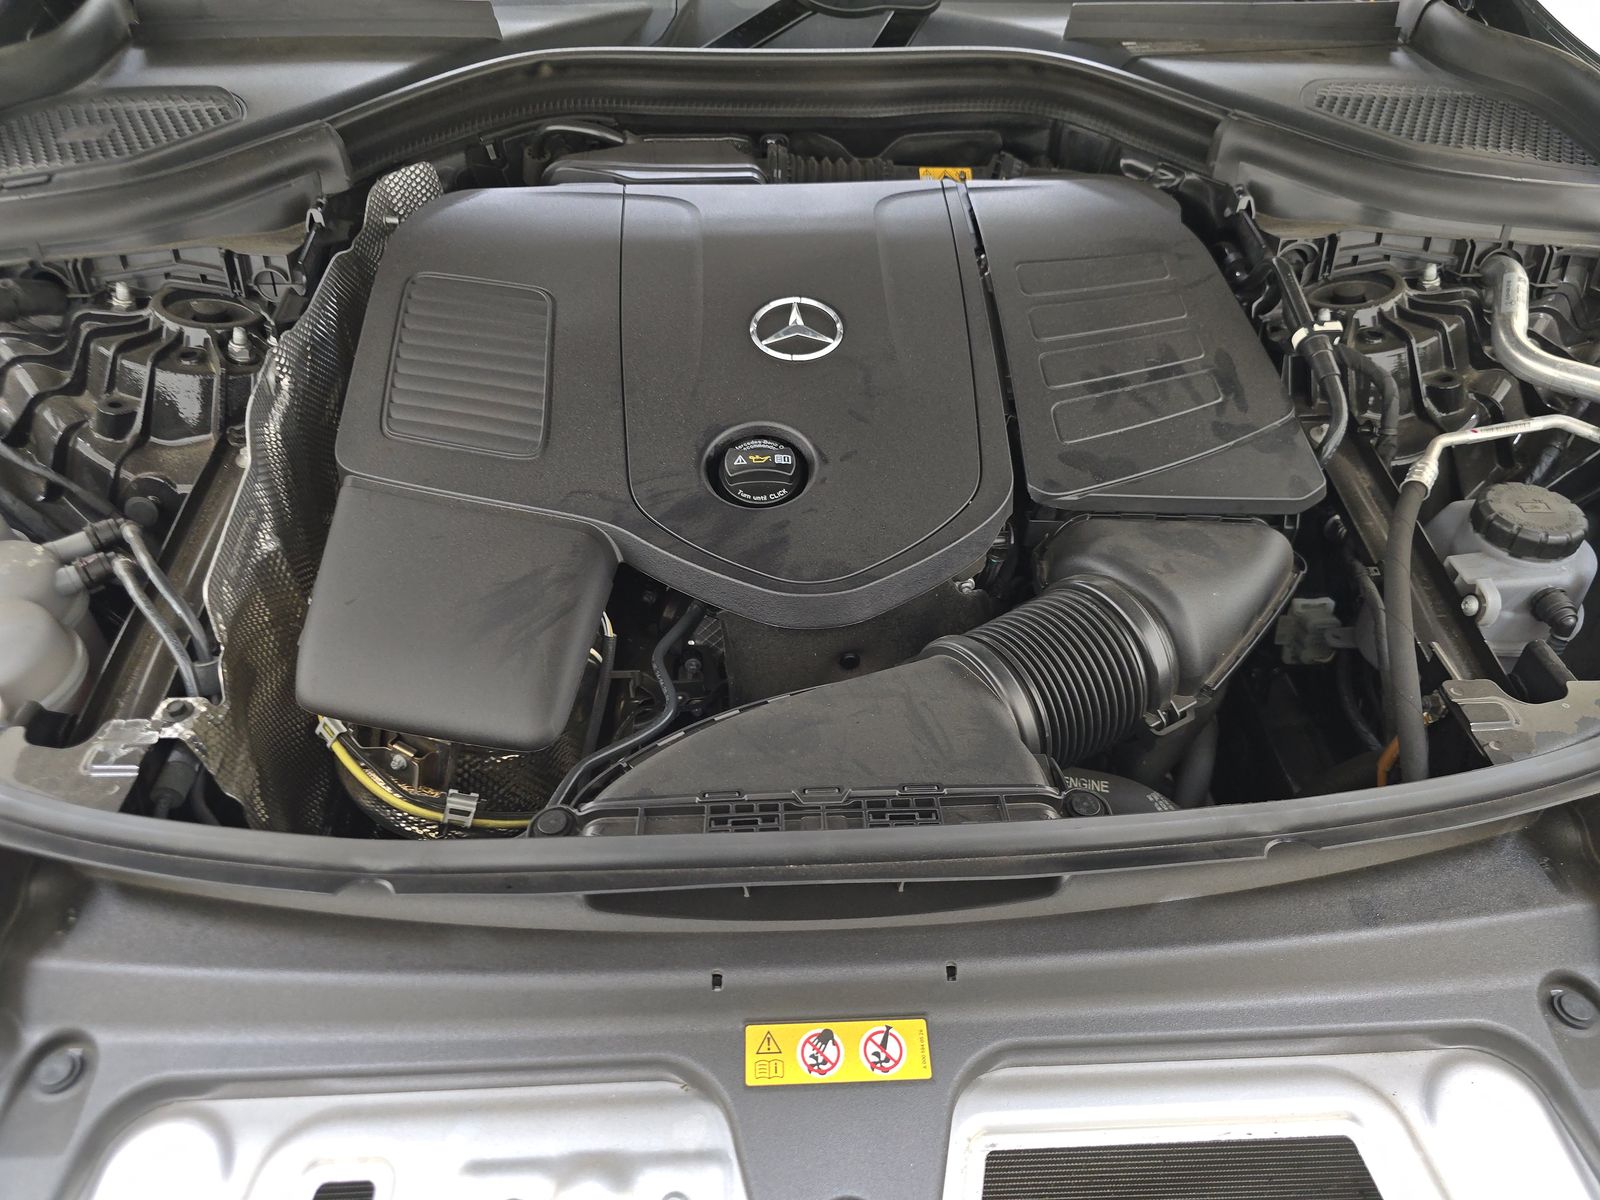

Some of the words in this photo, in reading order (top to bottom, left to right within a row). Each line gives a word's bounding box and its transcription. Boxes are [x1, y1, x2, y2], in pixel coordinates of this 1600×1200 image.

[737, 489, 752, 500] Turn
[769, 488, 789, 500] CLICK
[1064, 776, 1110, 793] ENGINE
